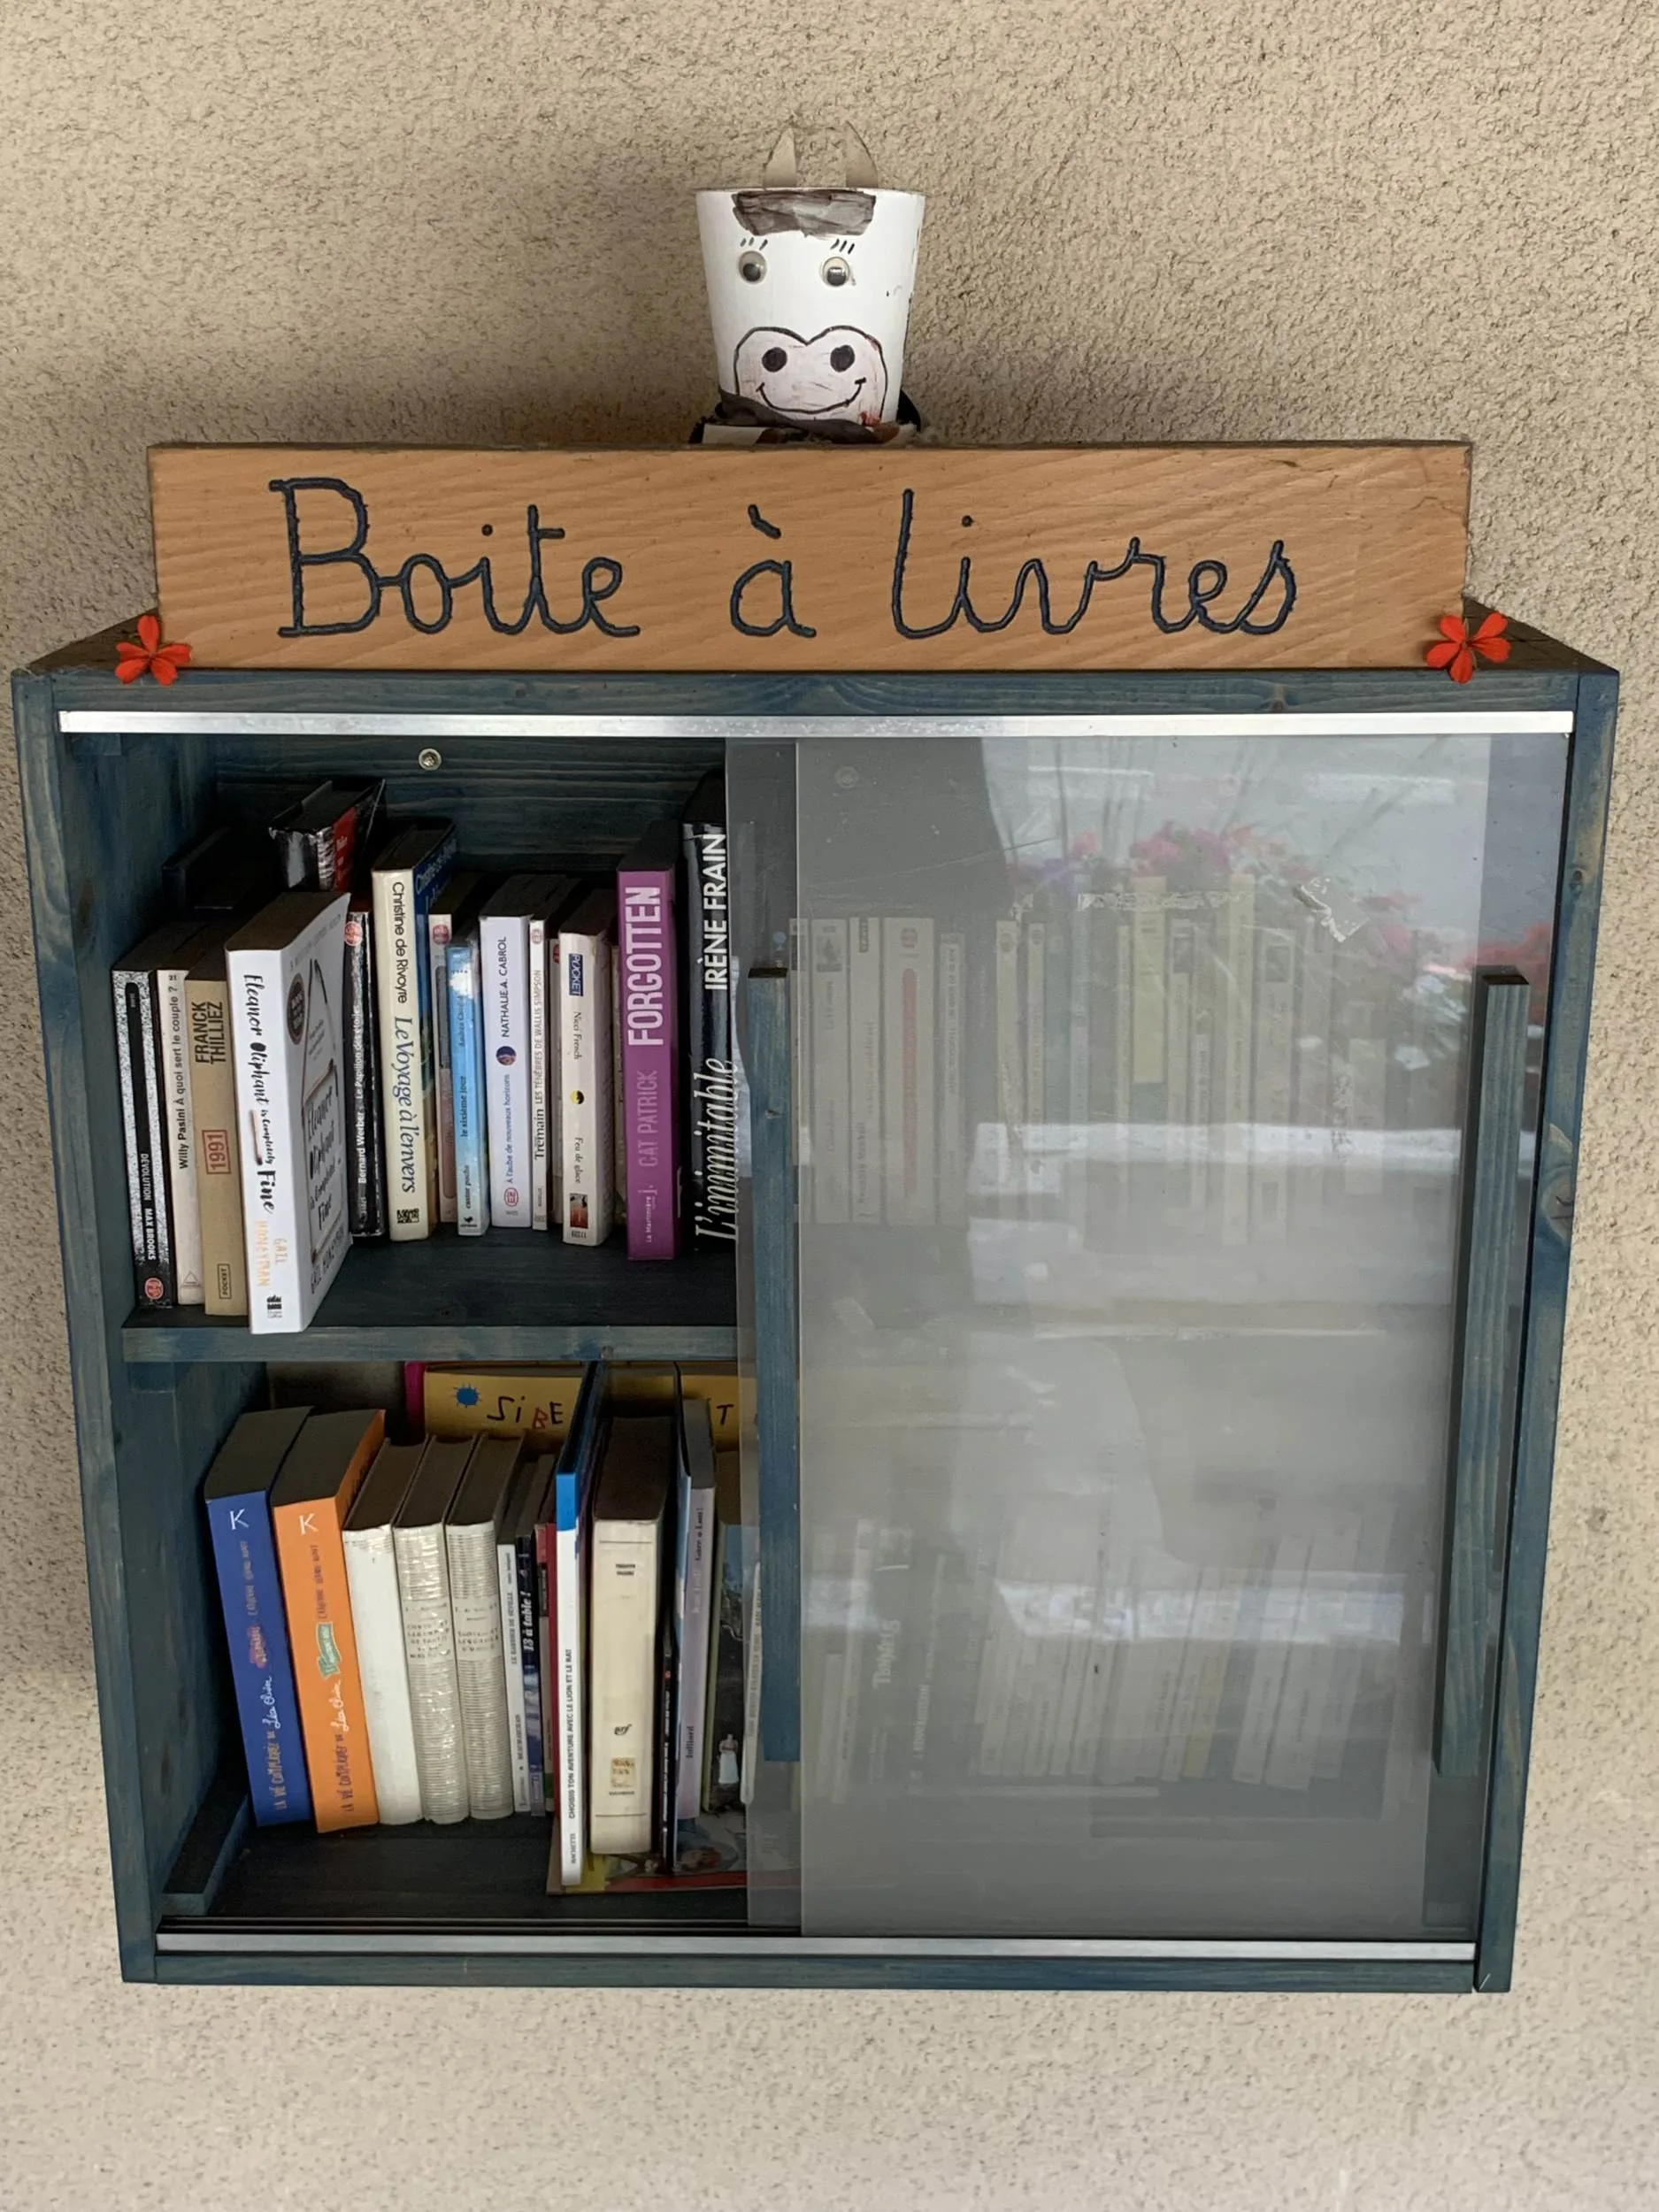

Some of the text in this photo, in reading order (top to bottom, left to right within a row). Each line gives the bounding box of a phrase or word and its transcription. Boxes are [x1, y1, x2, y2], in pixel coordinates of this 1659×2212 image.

[269, 475, 1298, 638] Boite à livres
[696, 833, 727, 991] IRÈNE FRAIN
[392, 881, 410, 1004] Christine de Rivoyre
[497, 937, 508, 977] CABROL
[571, 954, 582, 995] POCKET
[625, 887, 664, 1046] FORGOTTEN
[243, 973, 265, 1037] Eleanor
[533, 969, 542, 1006] SIMPSON
[169, 996, 183, 1033] couple
[499, 989, 511, 1038] NATHALIE
[534, 1007, 542, 1038] WALLIS
[171, 1034, 180, 1045] le
[192, 1002, 210, 1064] FRANCK
[206, 1002, 227, 1065] THILLIEZ
[534, 1039, 542, 1049] DE
[572, 1010, 583, 1060] Nicci French
[172, 1047, 182, 1068] sert
[249, 1041, 269, 1106] Oliphant
[173, 1071, 185, 1094] quoi
[502, 1074, 511, 1106] horizons
[534, 1091, 543, 1105] LES
[391, 1016, 419, 1194] Le Voyage à l'envers
[637, 1070, 658, 1167] CAT PATRICK
[176, 1108, 187, 1141] Pasini
[261, 1118, 275, 1165] Completely
[355, 1111, 365, 1146] Werber
[503, 1107, 512, 1143] nouveaux
[534, 1109, 546, 1161] Tremain
[179, 1143, 189, 1170] Willy
[207, 1132, 227, 1171] 1991
[356, 1147, 367, 1185] Bernard
[504, 1144, 512, 1154] de
[573, 1136, 584, 1184] Feu de glace
[695, 1058, 738, 1240] L'inimitable
[257, 1169, 277, 1214] Fine
[144, 1208, 155, 1226] MAX
[146, 1228, 157, 1261] BROOKS
[254, 1220, 271, 1287] HONEYMAN
[274, 1237, 288, 1265] GAIL
[220, 1268, 229, 1296] POCKET
[229, 1509, 249, 1531] K
[299, 1513, 318, 1535] K
[521, 1598, 533, 1624] table
[523, 1639, 534, 1652] 13
[565, 1664, 572, 1673] LE
[565, 1674, 572, 1684] ET
[565, 1703, 572, 1712] LE
[565, 1734, 574, 1771] AVENTURE
[566, 1789, 576, 1819] CHOISIS
